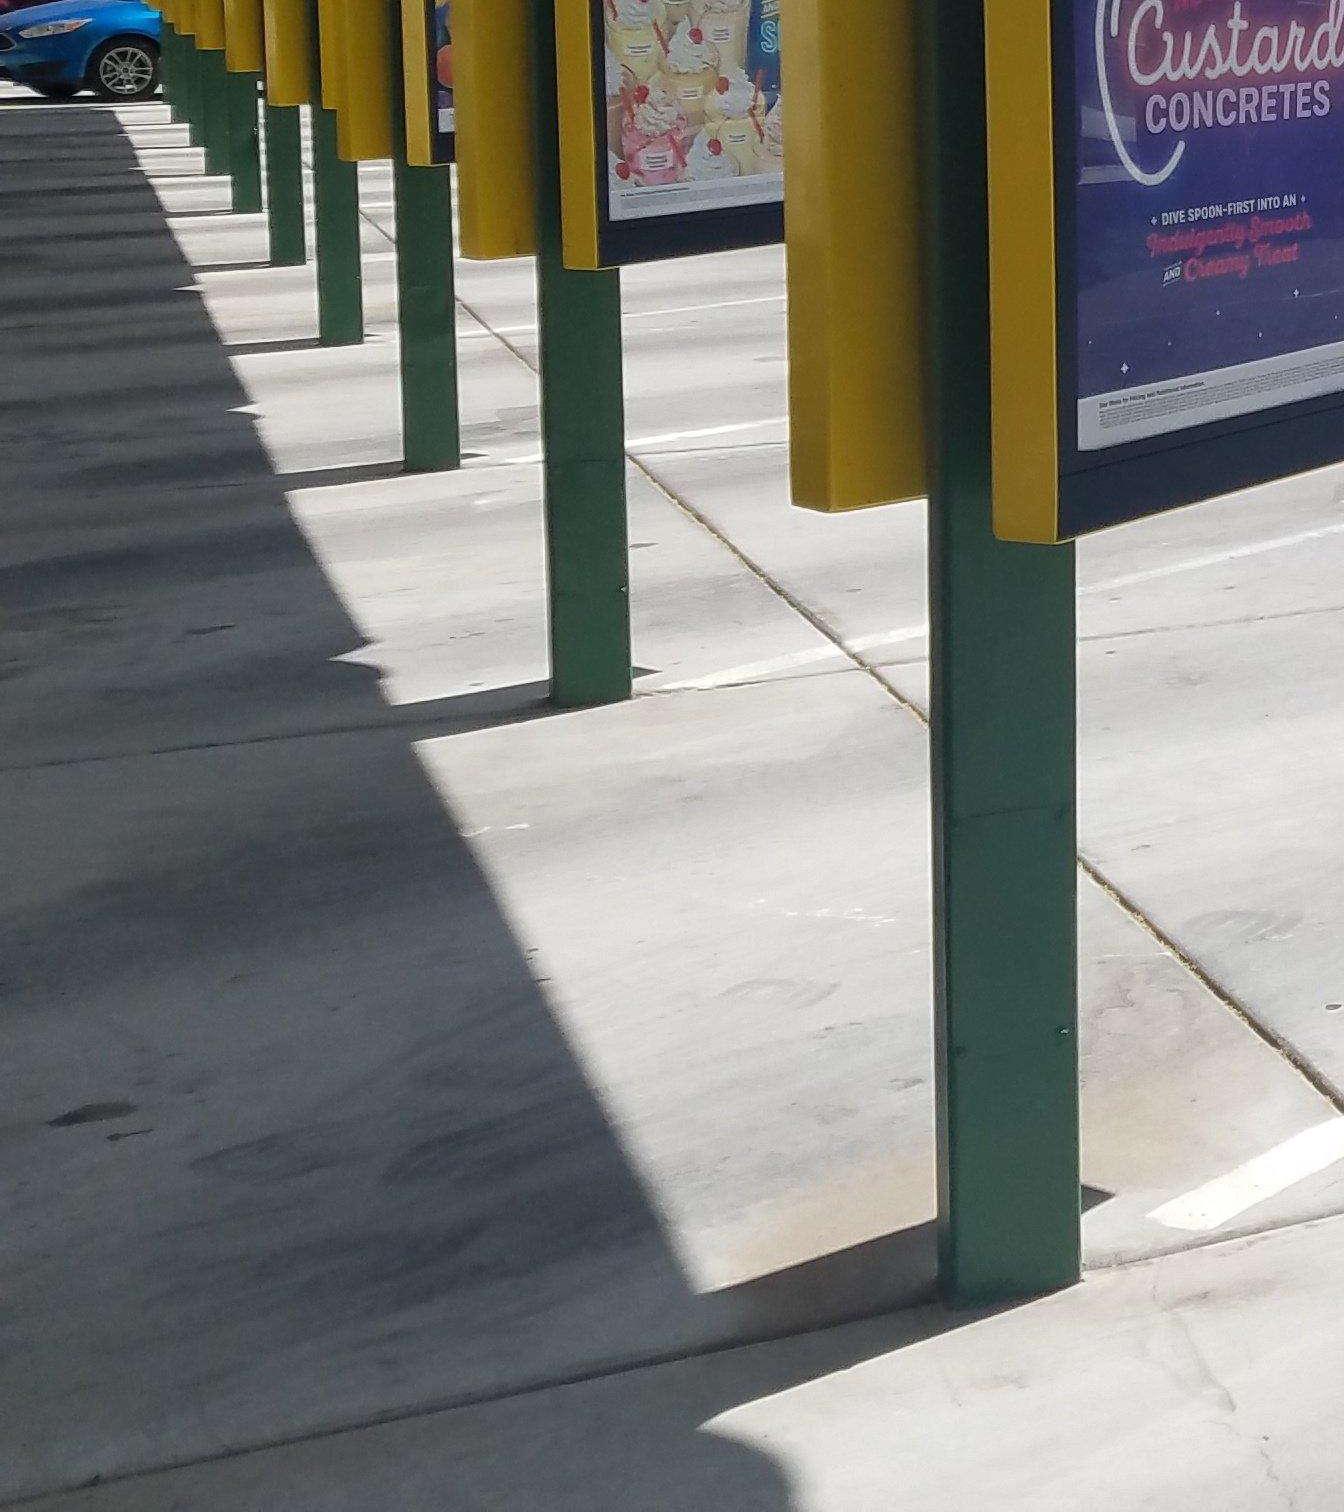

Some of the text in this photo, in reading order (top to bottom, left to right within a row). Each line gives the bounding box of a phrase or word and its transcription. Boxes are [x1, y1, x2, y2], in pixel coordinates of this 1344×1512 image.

[1145, 79, 1331, 135] CONCRETES
[1161, 194, 1297, 226] DIVE SPOON-FIRST INTO AN
[1162, 266, 1182, 283] AND
